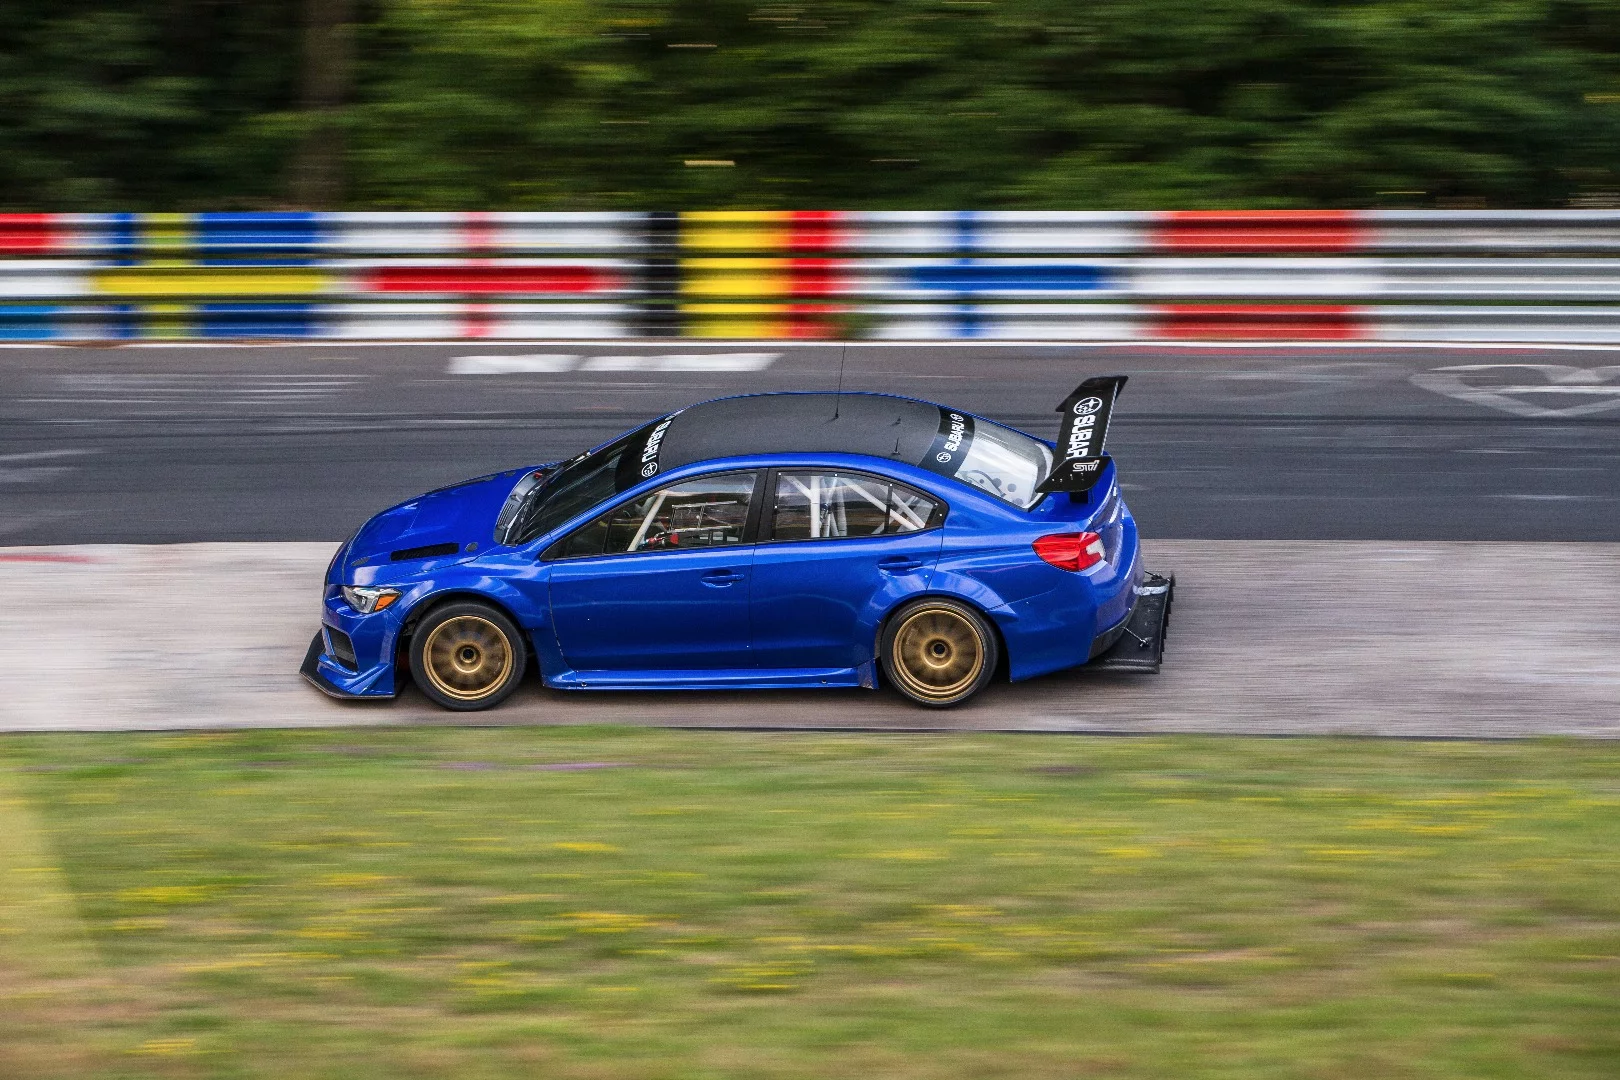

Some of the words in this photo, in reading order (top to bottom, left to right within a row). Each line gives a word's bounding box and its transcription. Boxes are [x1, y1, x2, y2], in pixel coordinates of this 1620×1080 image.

[642, 420, 671, 463] SUBARU
[944, 420, 965, 452] SUBARU
[1066, 414, 1096, 460] SUBAR
